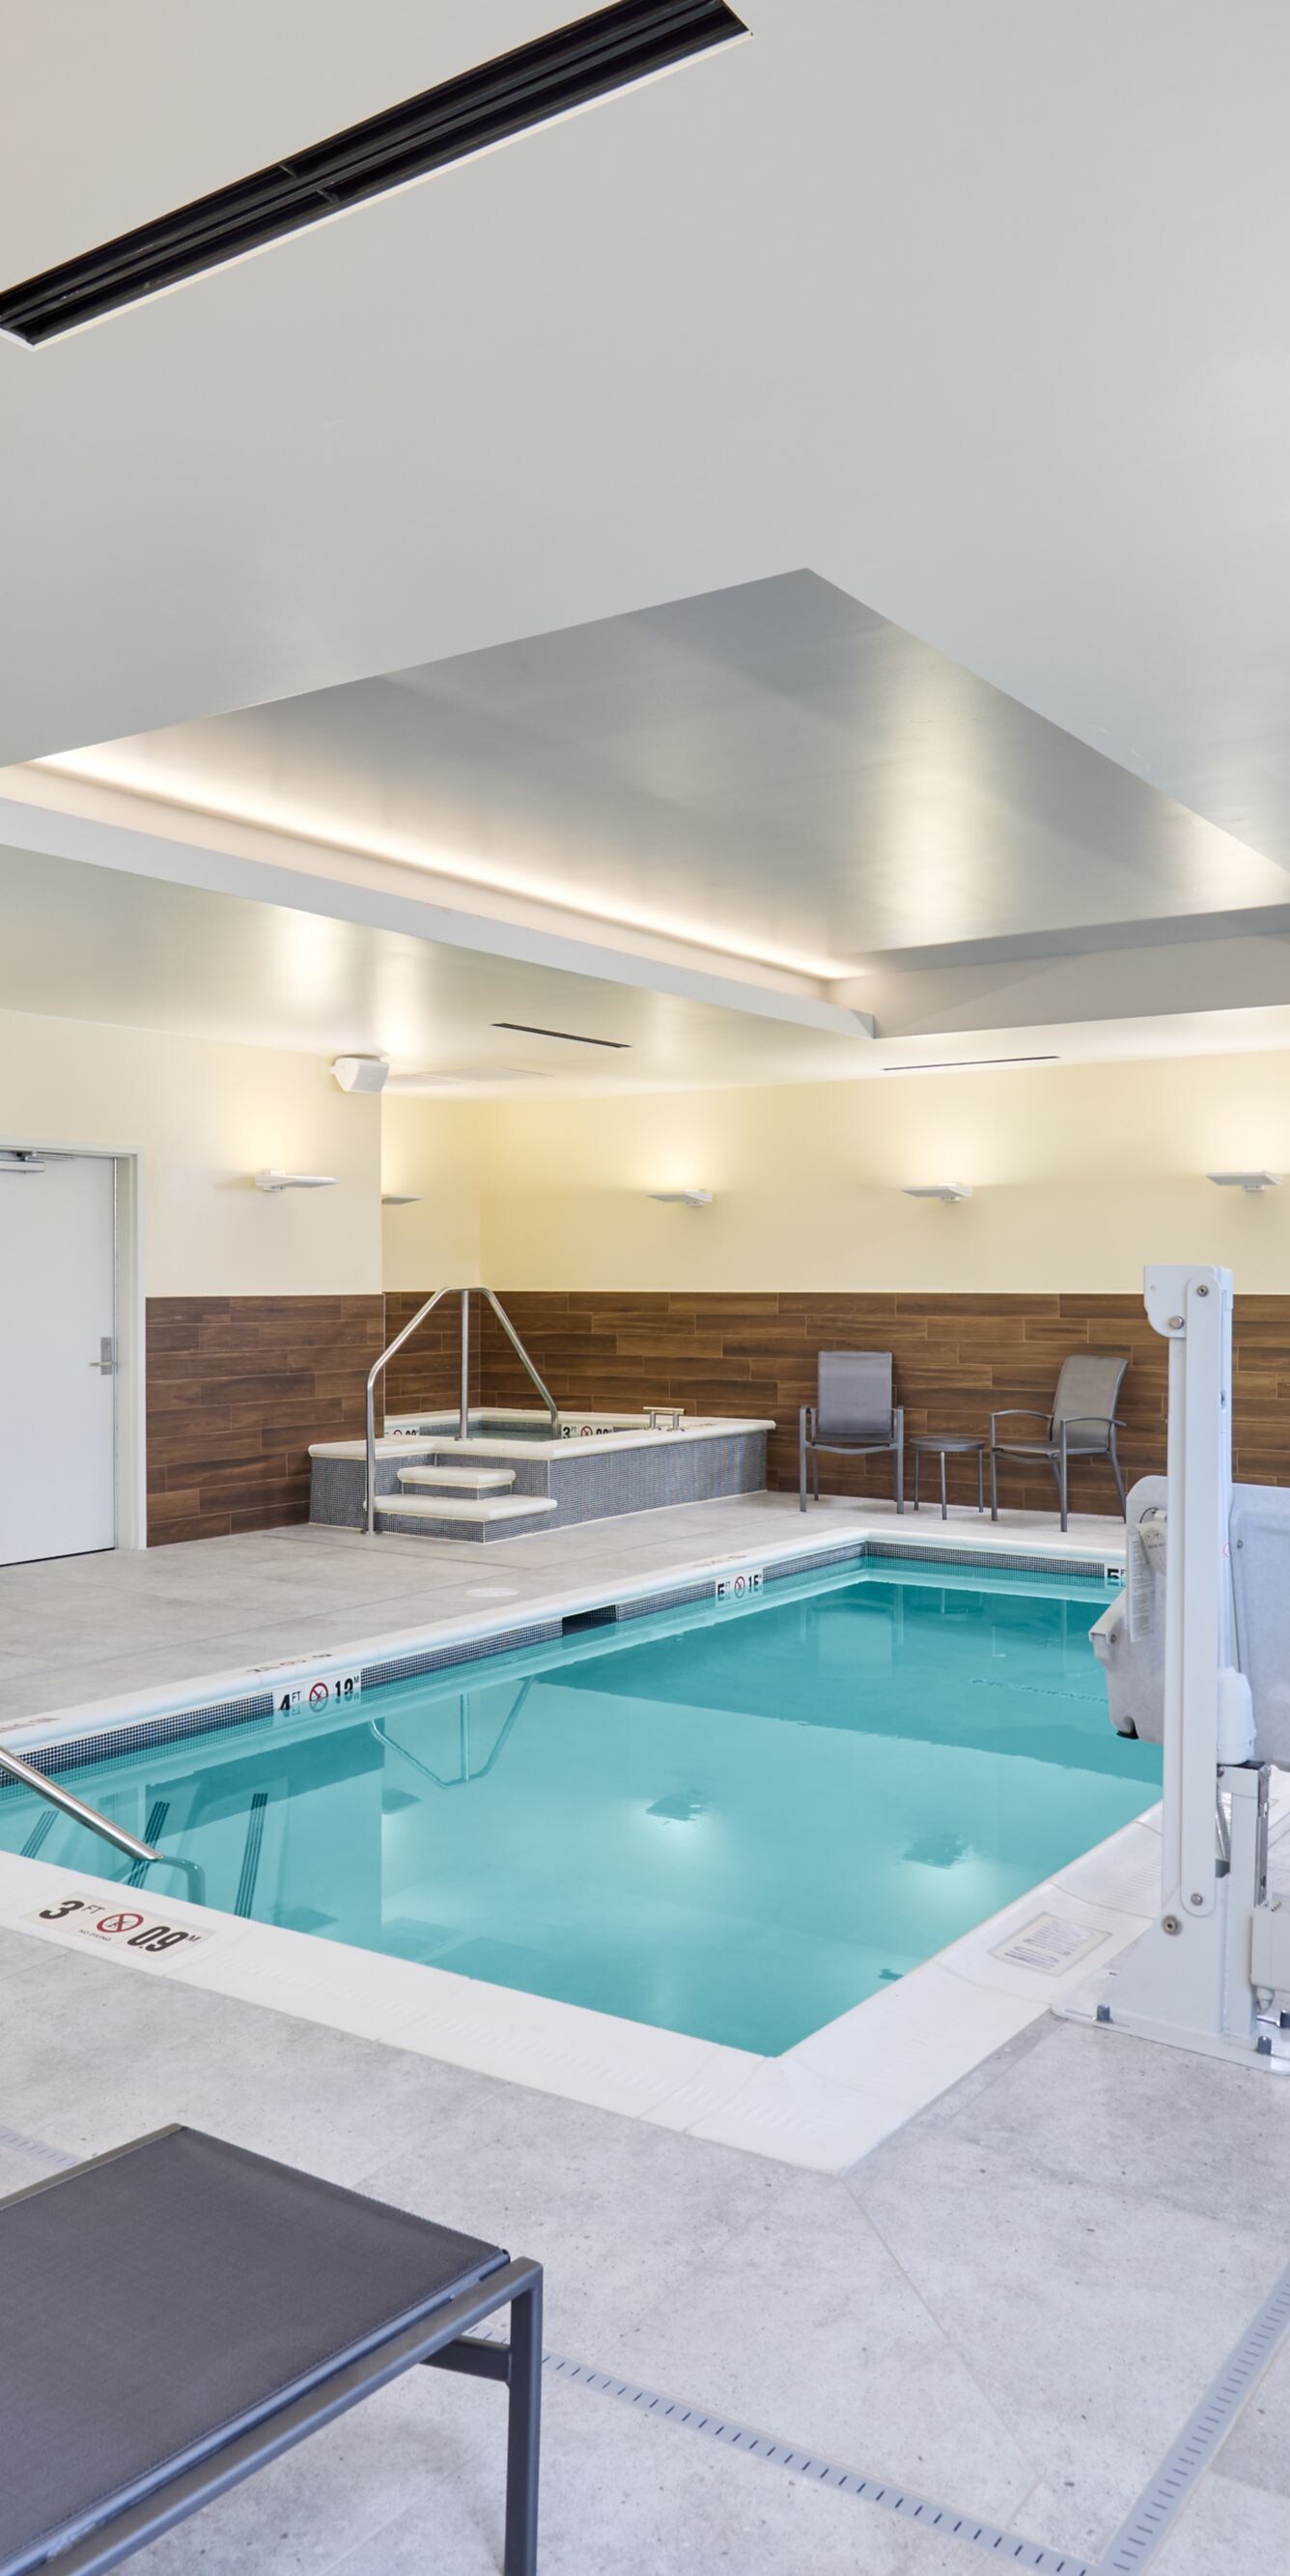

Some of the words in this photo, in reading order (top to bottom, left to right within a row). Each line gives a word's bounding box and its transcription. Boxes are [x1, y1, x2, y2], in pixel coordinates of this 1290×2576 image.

[279, 1693, 291, 1711] 4
[39, 1900, 85, 1919] 3
[82, 1904, 105, 1915] FT
